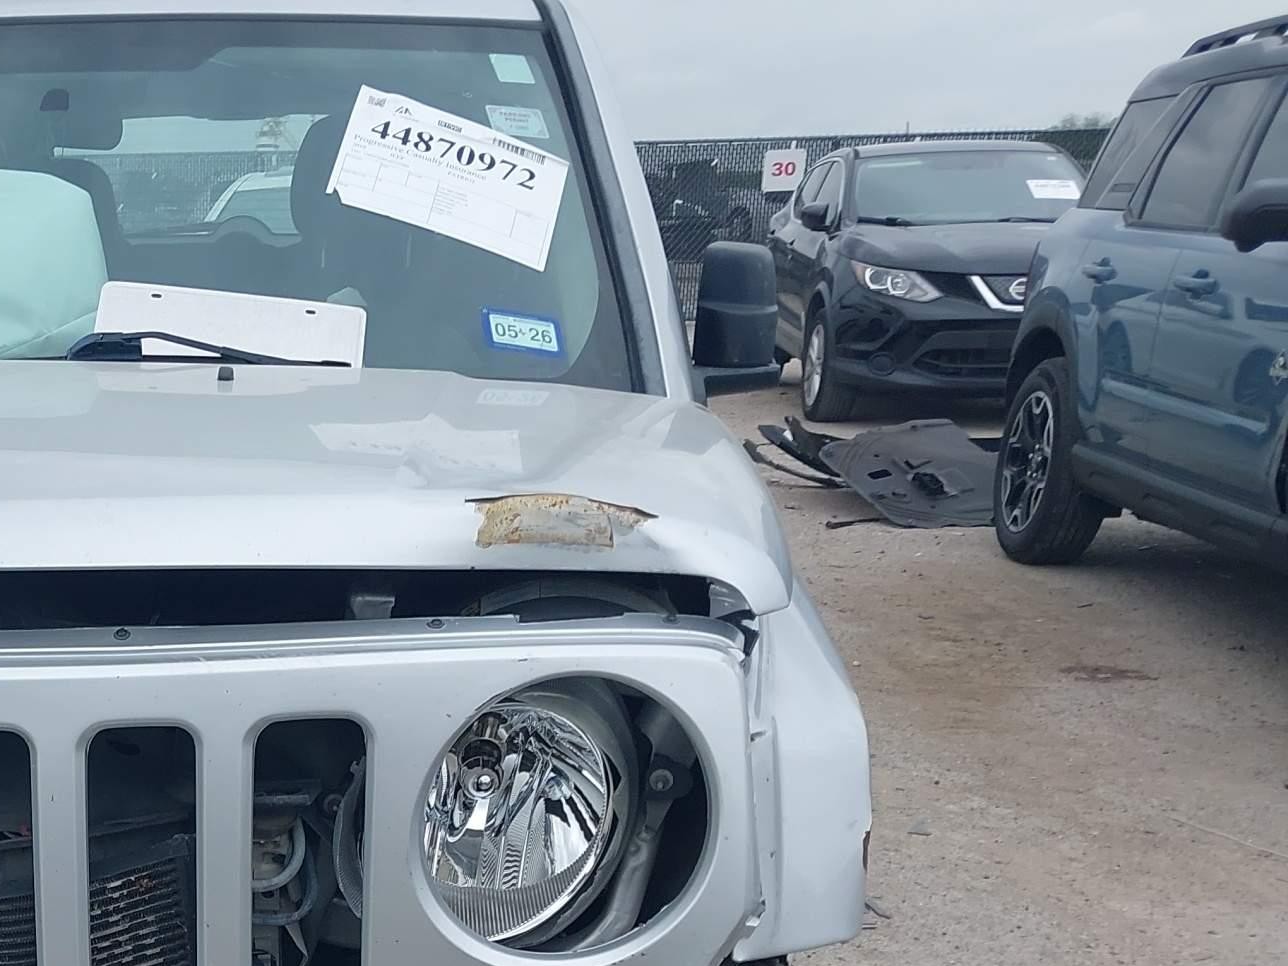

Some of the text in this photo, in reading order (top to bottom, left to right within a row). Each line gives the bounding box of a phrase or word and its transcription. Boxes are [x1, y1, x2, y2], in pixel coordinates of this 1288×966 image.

[354, 134, 406, 156] Progressive
[445, 161, 488, 181] Insurance
[371, 120, 536, 190] 44870972
[771, 161, 796, 177] 30
[495, 322, 553, 344] 05 26
